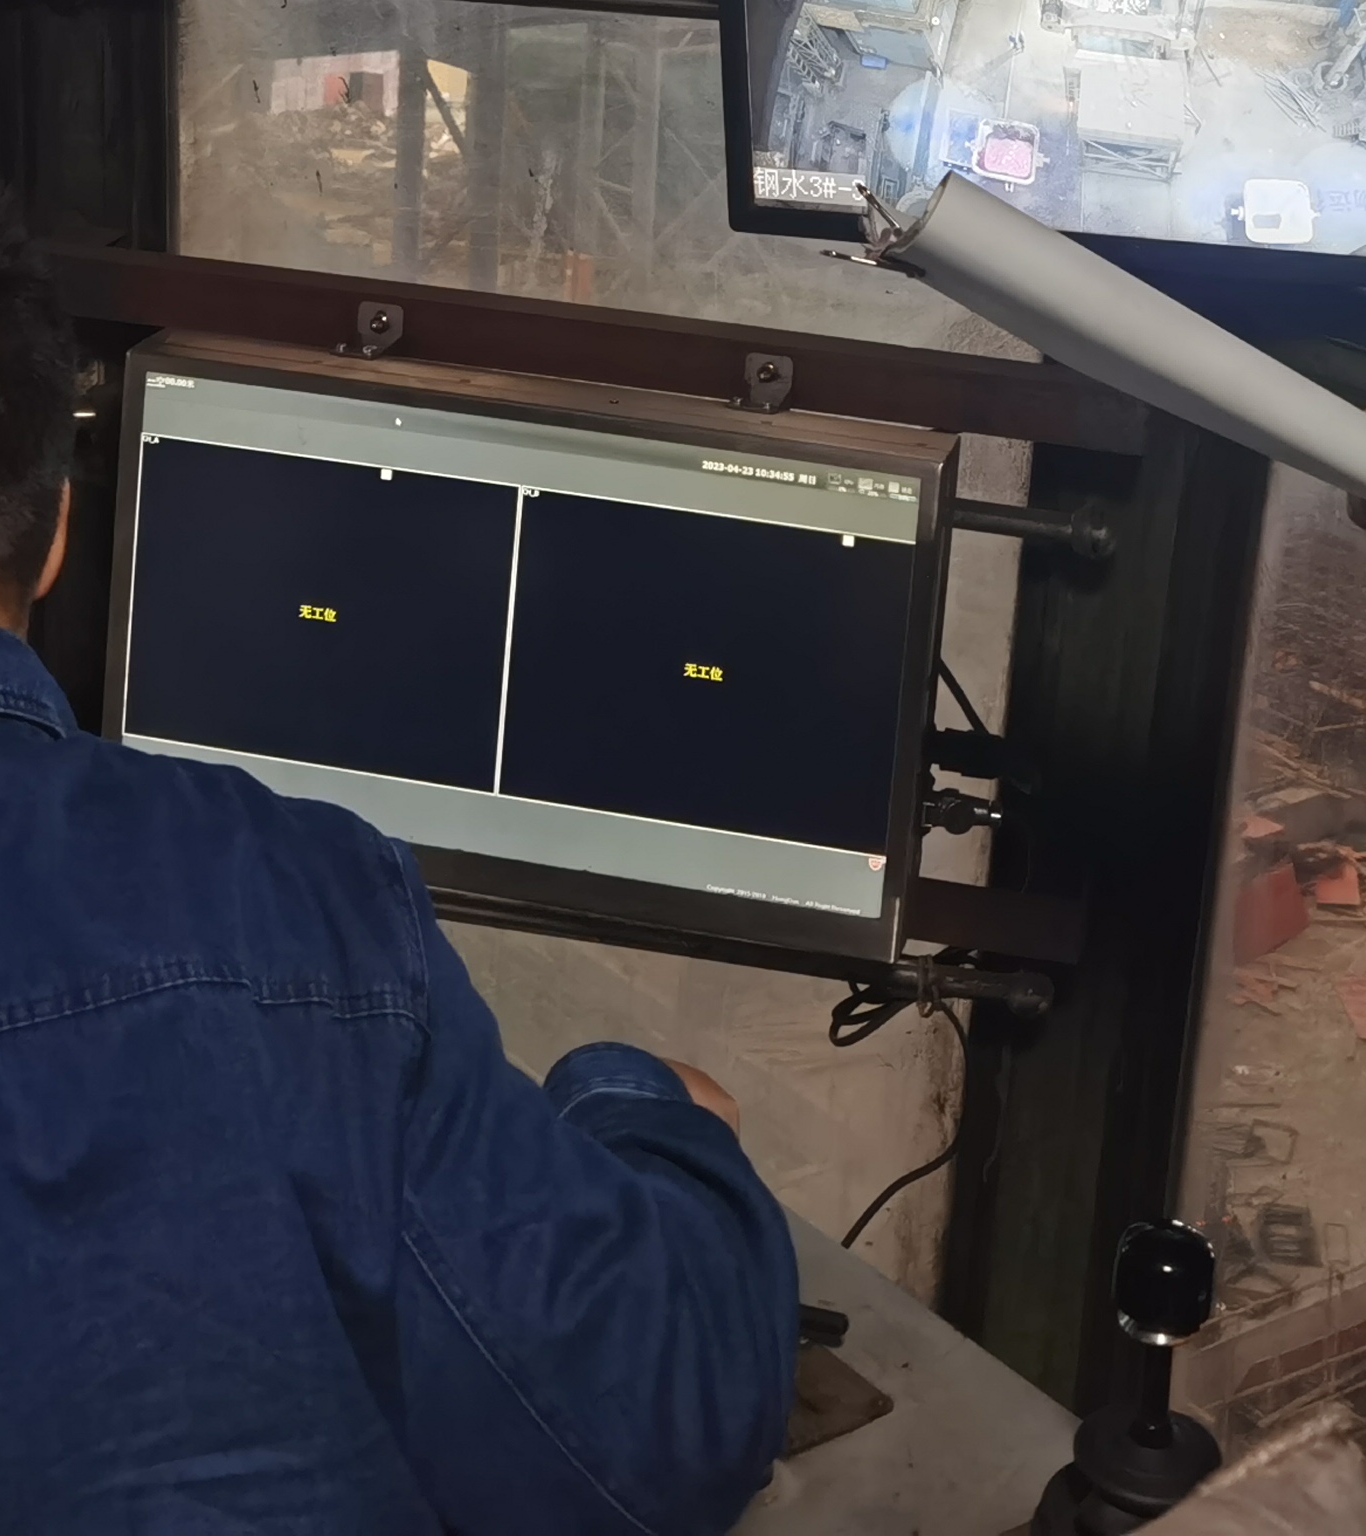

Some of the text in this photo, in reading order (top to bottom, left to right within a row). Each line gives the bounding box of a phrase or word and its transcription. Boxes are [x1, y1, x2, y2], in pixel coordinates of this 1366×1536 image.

[702, 460, 754, 477] 2023-04-23
[755, 467, 795, 482] 10:34:55
[298, 604, 337, 623] 无工位
[683, 662, 724, 682] 无工位
